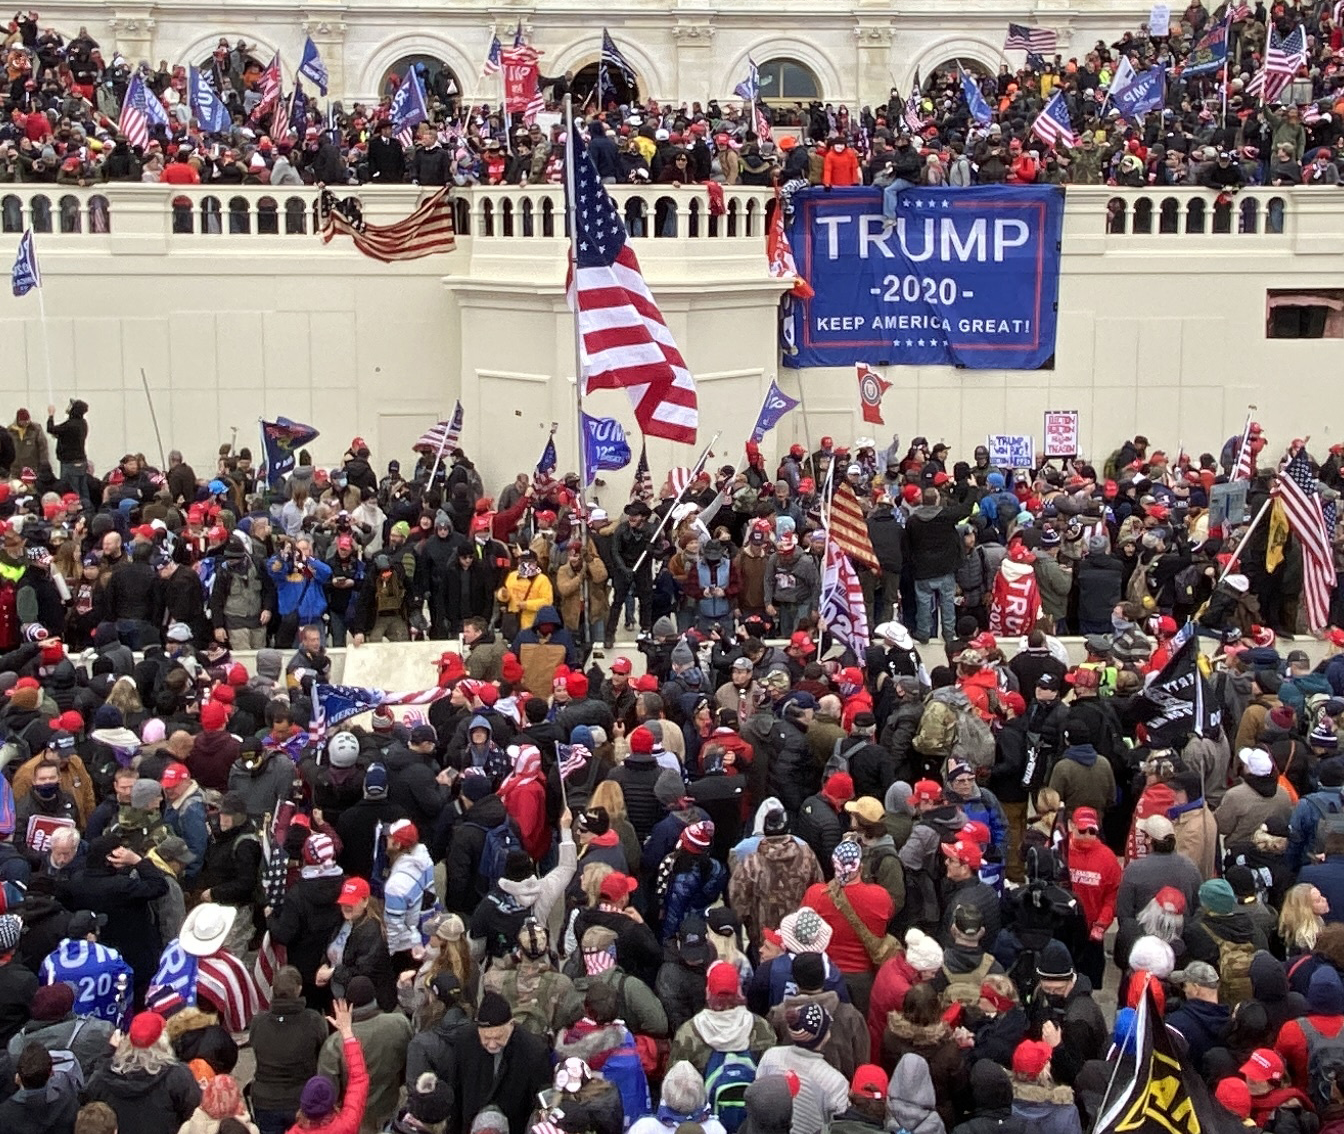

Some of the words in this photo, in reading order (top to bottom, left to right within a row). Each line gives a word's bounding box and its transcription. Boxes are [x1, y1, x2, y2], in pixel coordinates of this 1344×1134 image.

[815, 214, 1030, 263] TRUMP
[817, 317, 865, 331] KEEP
[871, 315, 952, 332] AMERICA
[957, 319, 1031, 334] GREAT!
[996, 436, 1024, 446] TRUMP
